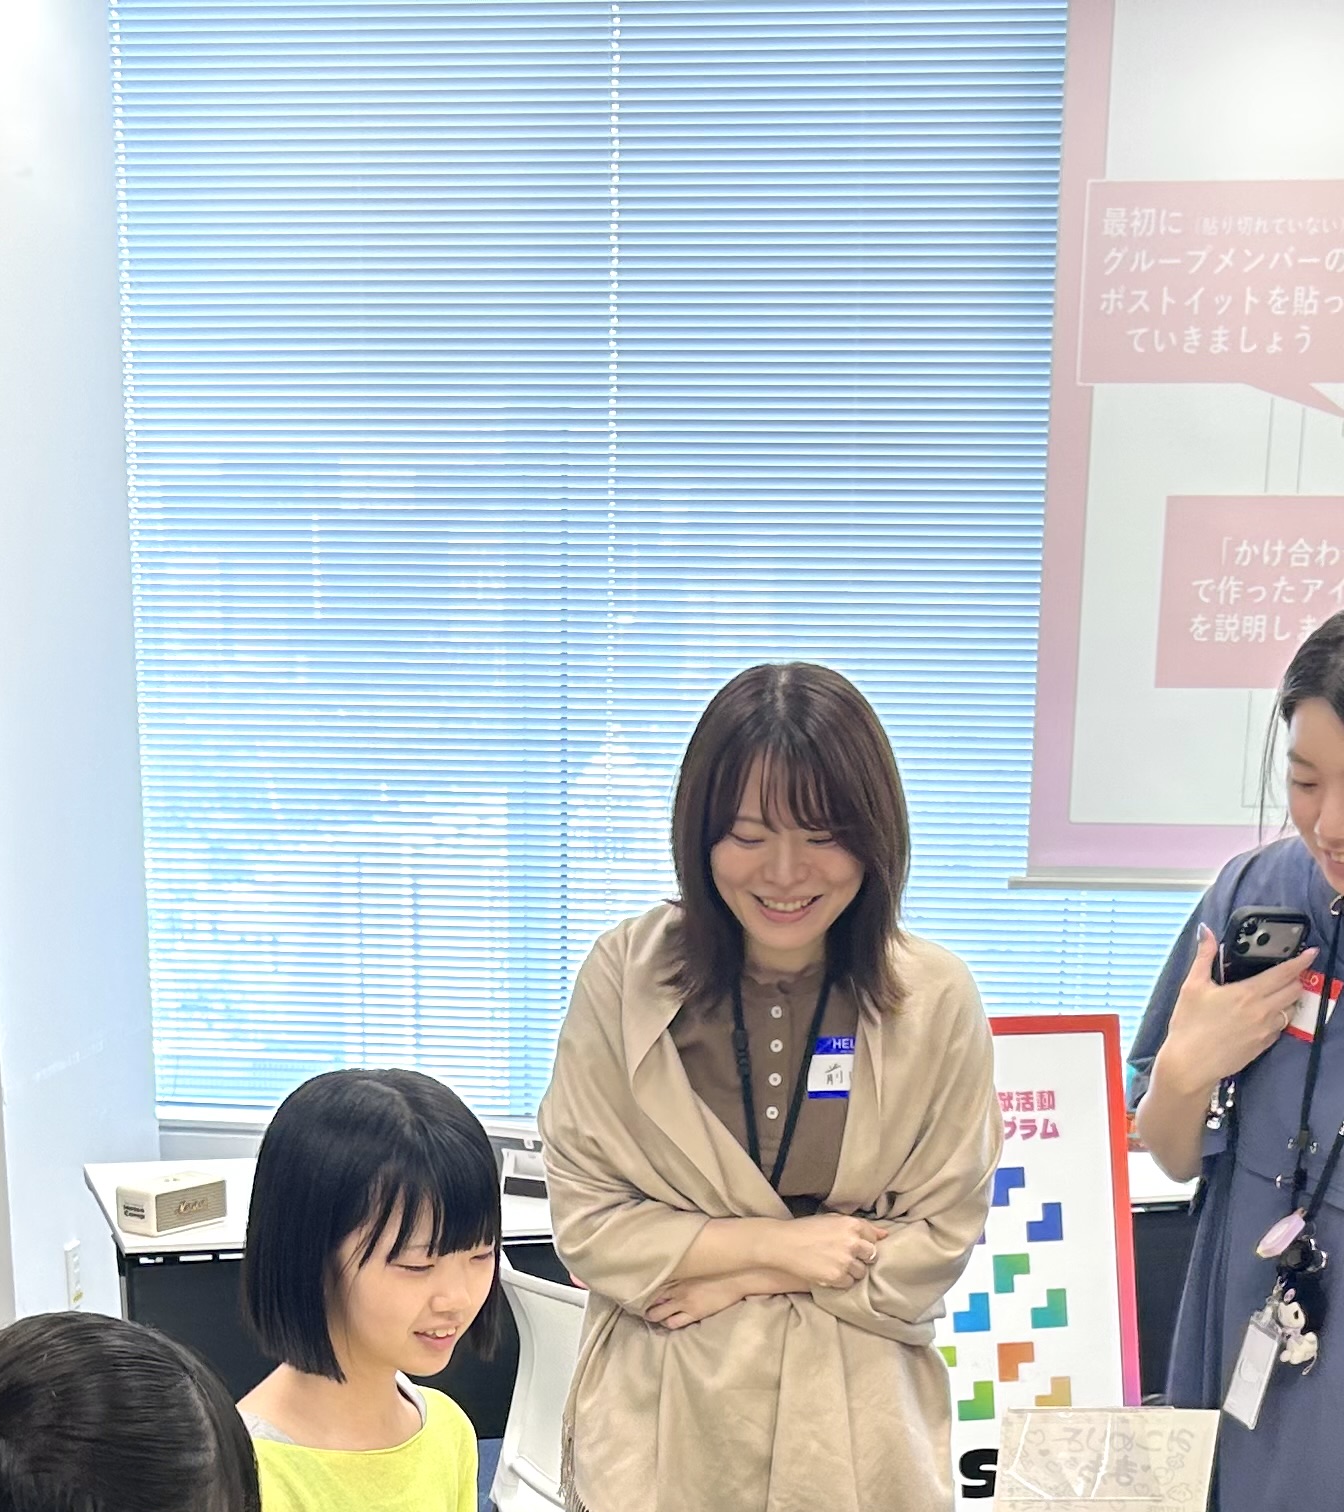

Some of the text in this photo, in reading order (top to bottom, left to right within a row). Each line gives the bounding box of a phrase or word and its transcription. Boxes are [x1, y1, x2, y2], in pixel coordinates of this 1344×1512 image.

[1102, 207, 1184, 237] 最初に
[1099, 285, 1344, 316] ポストイットを貼っ
[1125, 325, 1313, 354] ていきましょう
[832, 1037, 855, 1050] HEL
